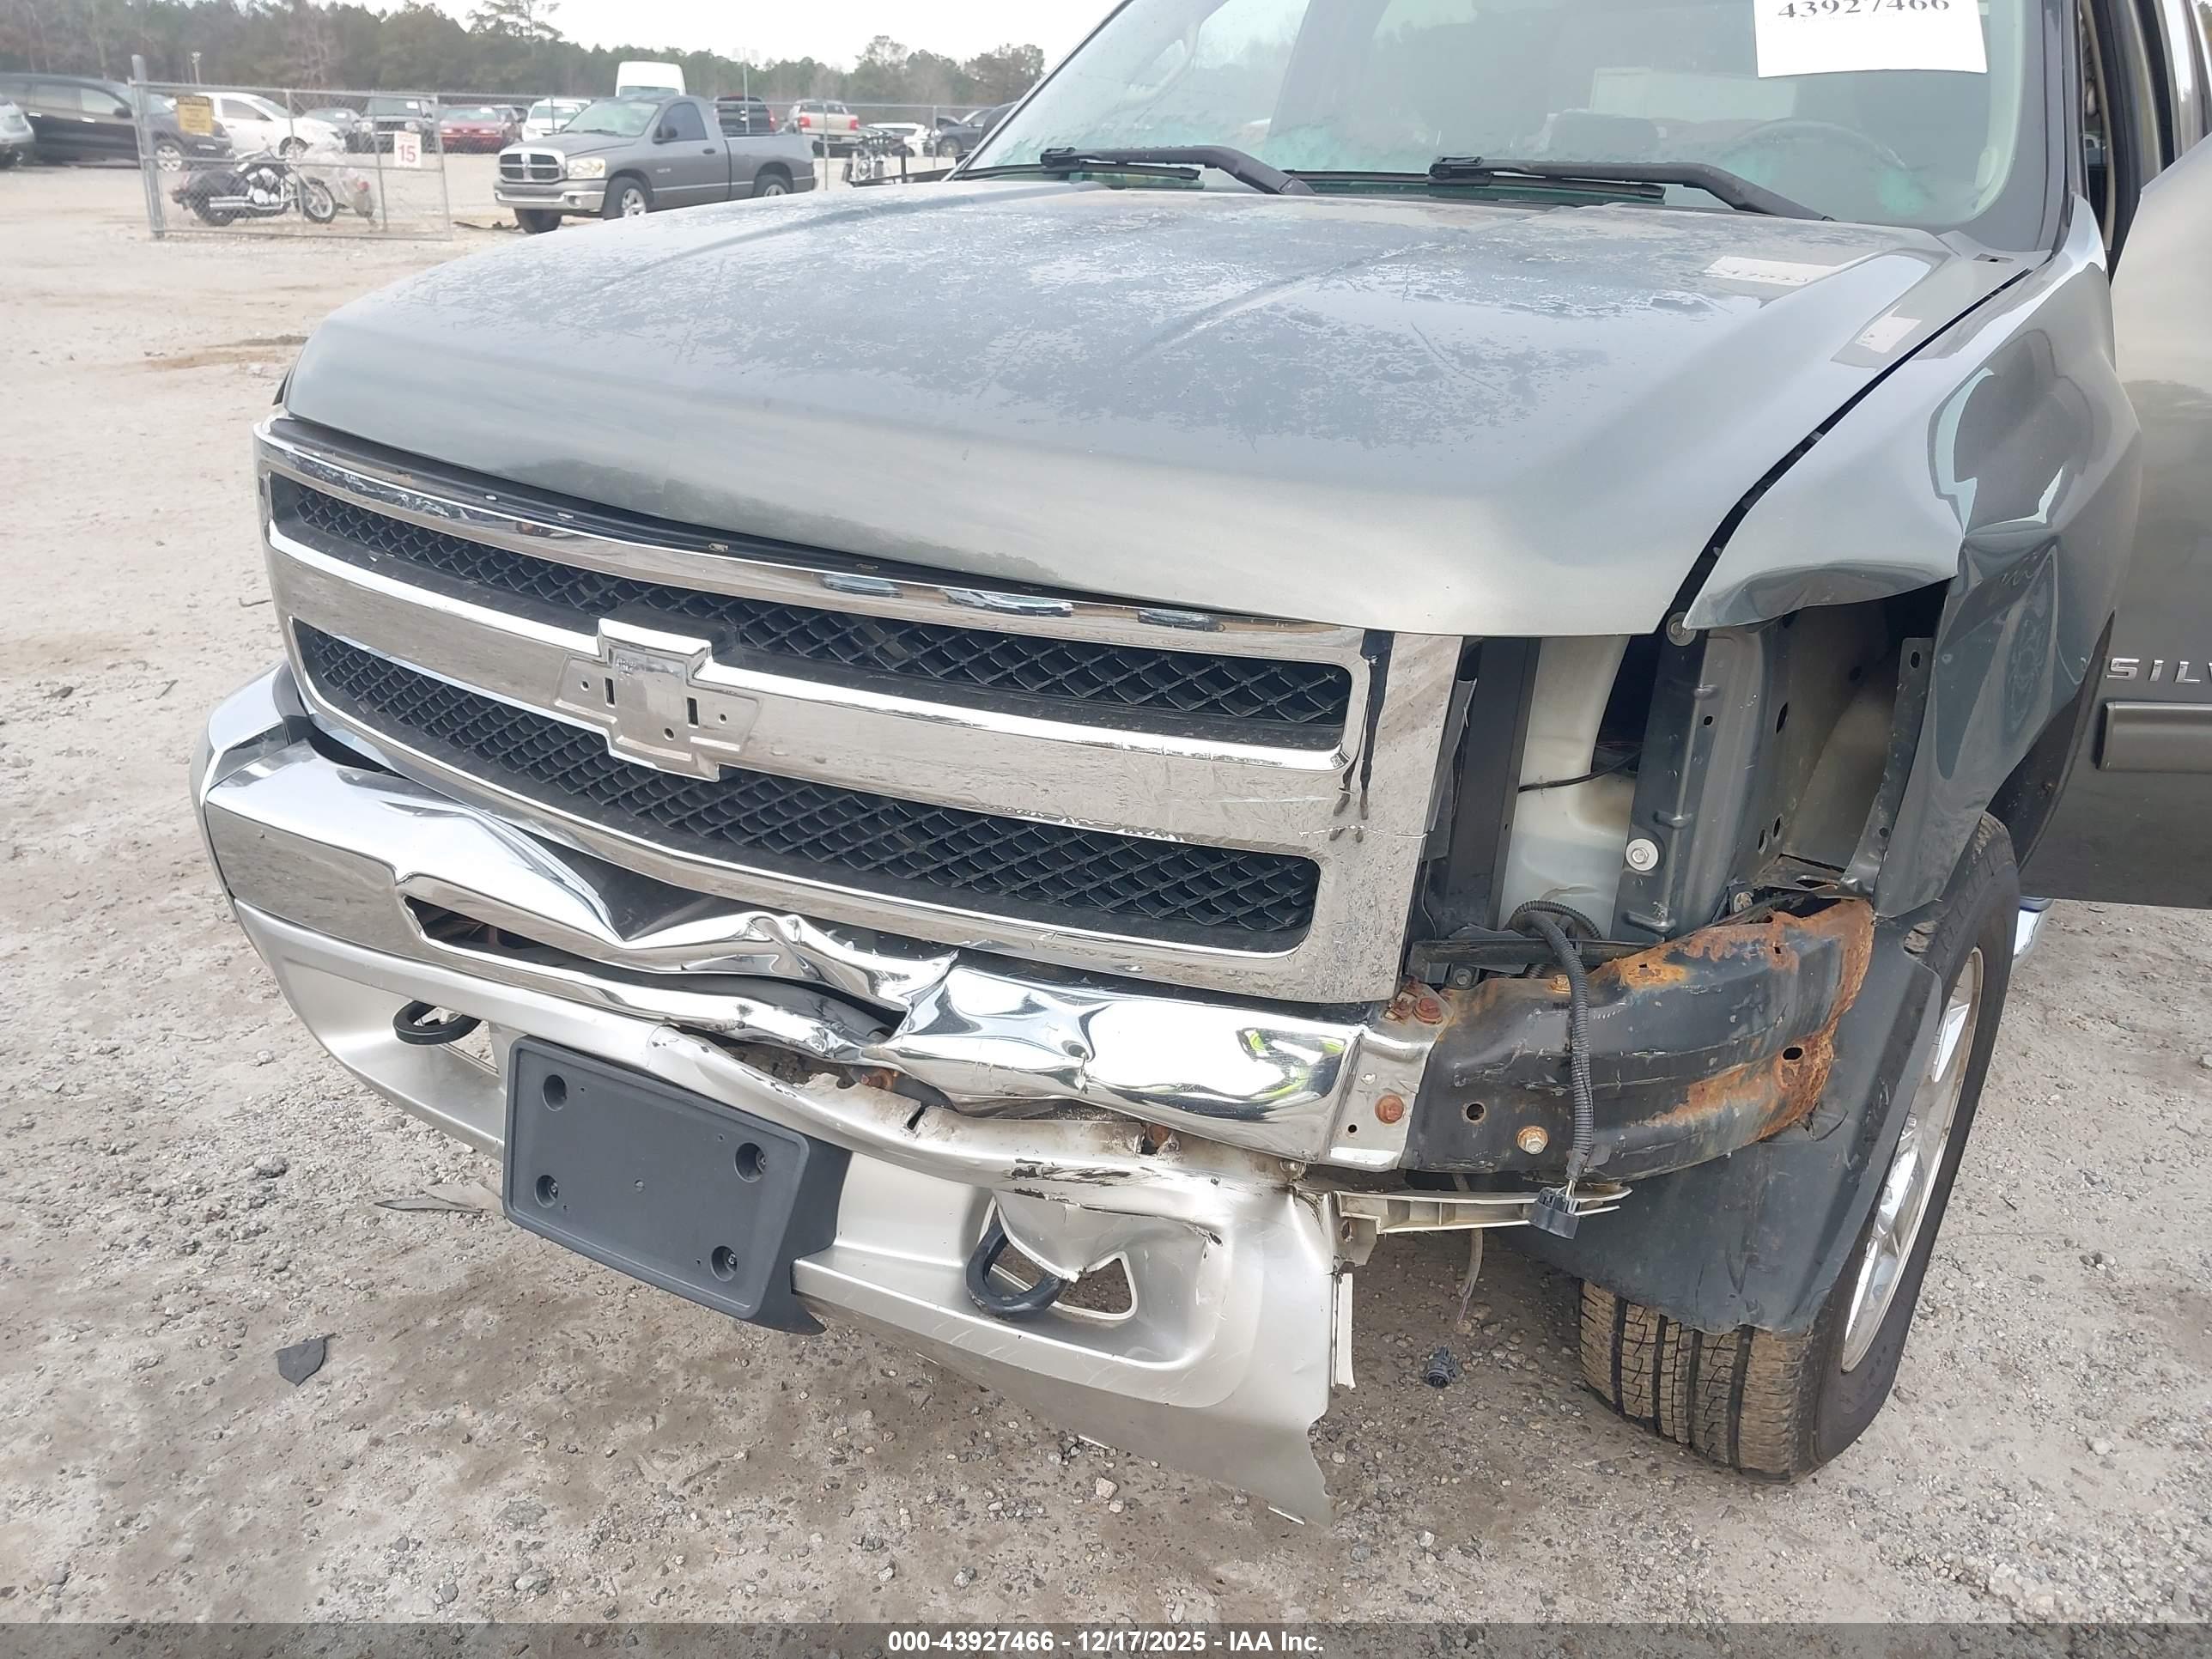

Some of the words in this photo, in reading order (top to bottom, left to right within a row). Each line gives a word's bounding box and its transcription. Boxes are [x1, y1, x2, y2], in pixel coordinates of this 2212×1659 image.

[1778, 0, 1950, 18] 43927466
[398, 144, 416, 163] 15
[2105, 657, 2212, 684] SIL
